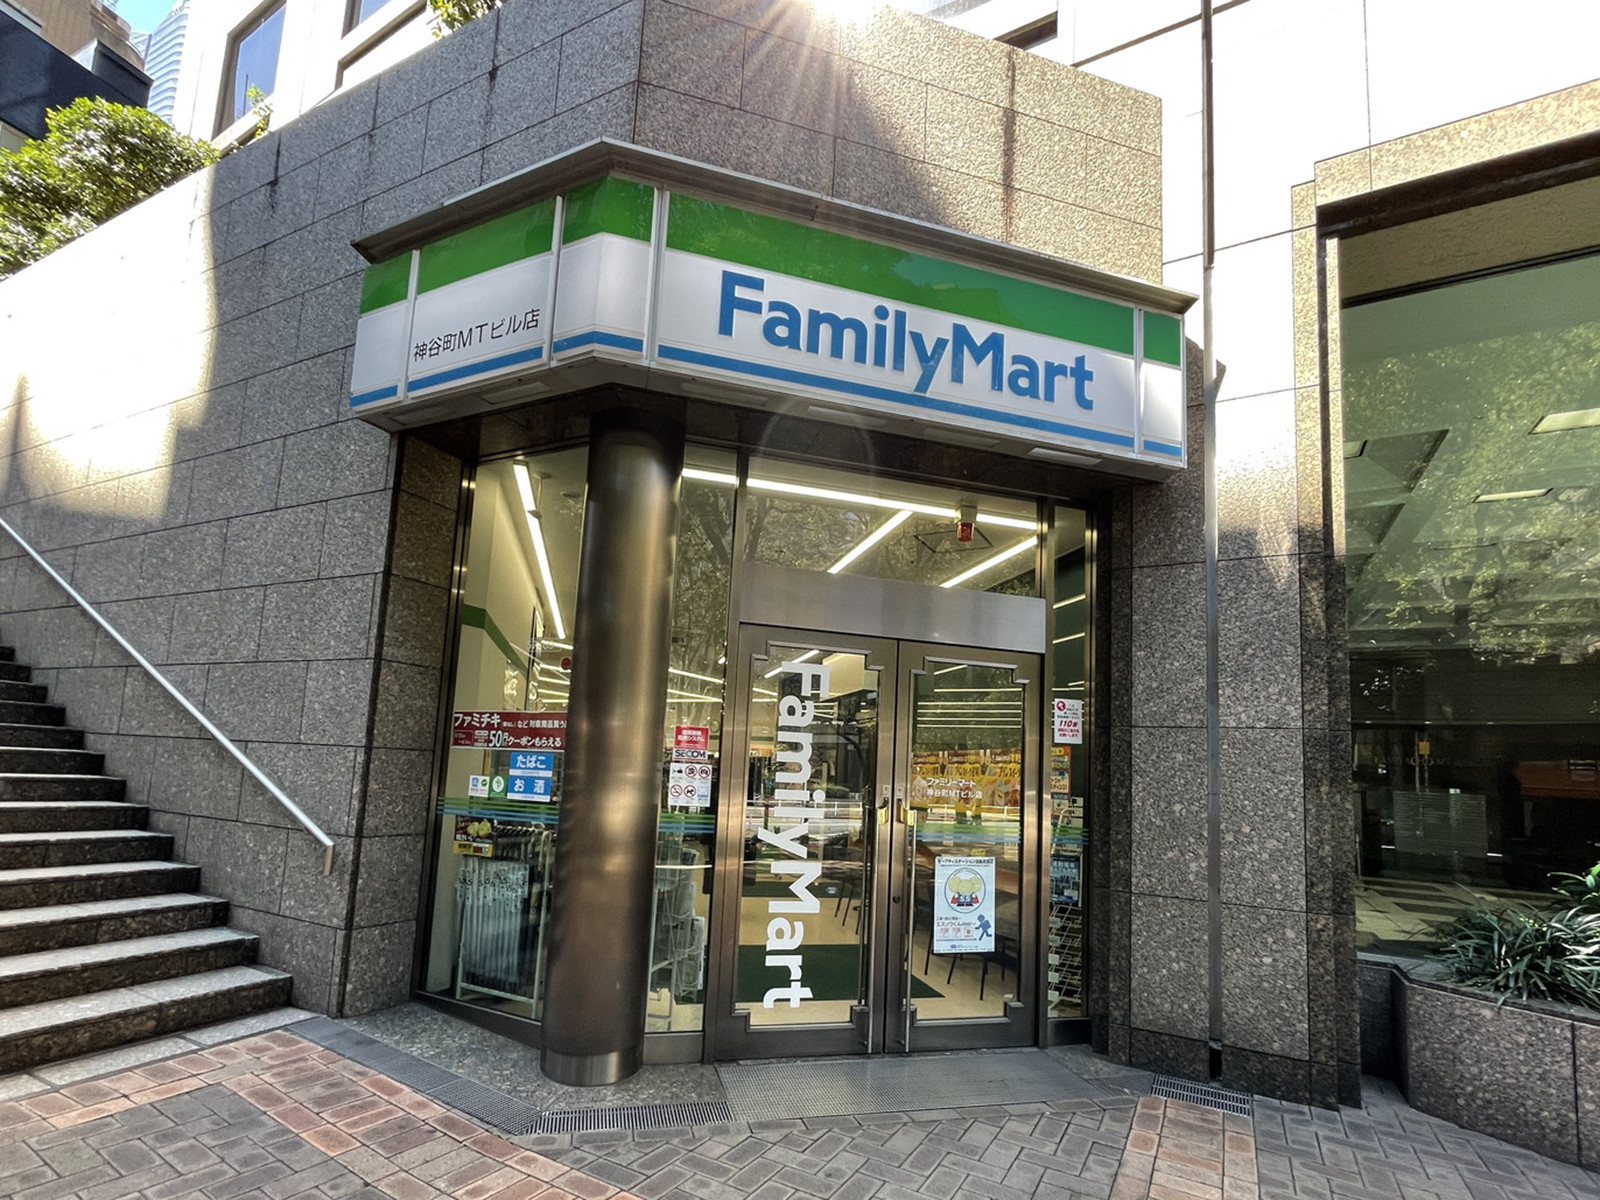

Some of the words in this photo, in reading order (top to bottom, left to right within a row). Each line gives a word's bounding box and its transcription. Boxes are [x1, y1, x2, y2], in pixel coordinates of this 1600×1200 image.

[413, 309, 540, 362] 神谷町MTビル店
[718, 270, 1094, 411] FamilyMart
[454, 713, 501, 728] ファミチキ
[516, 754, 546, 769] たばこ
[675, 750, 706, 758] SECOM
[926, 778, 977, 788] ファミリーマート
[762, 660, 831, 1009] FamilyMart
